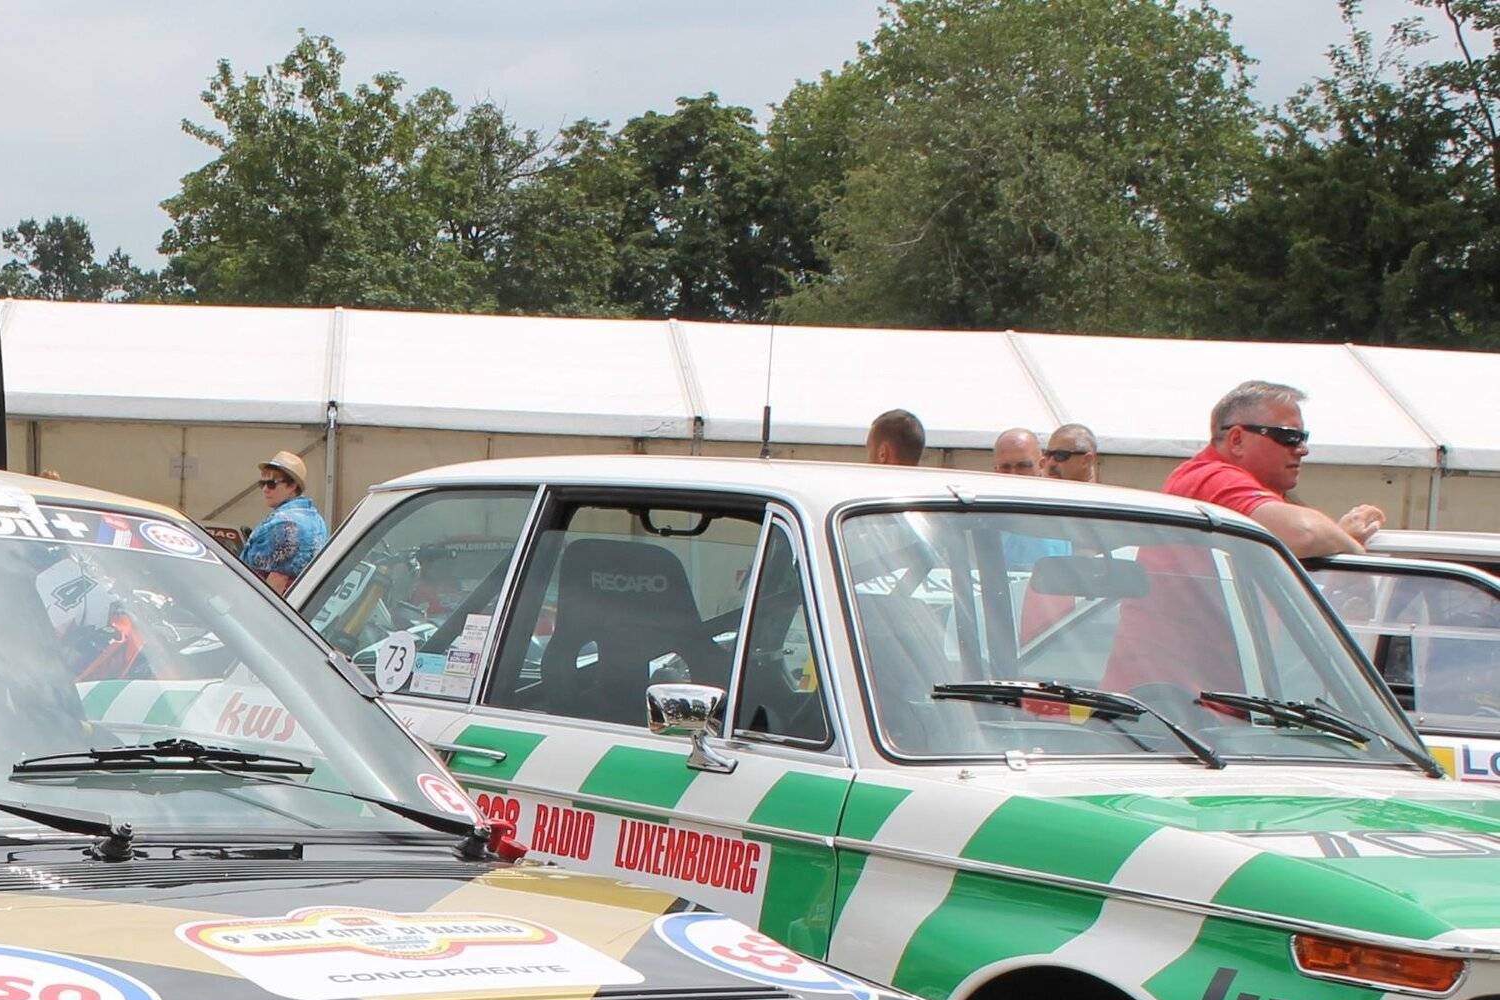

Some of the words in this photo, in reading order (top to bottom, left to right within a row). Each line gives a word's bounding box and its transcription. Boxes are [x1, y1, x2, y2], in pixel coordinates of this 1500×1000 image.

[590, 571, 668, 593] RECARO
[383, 645, 408, 673] 73
[531, 803, 596, 862] RADIO
[614, 818, 762, 895] LUXEMBOURG
[252, 929, 320, 942] RALLY
[397, 925, 424, 935] DI
[425, 924, 525, 935] BASSANO
[327, 963, 572, 984] CONCORRENTE
